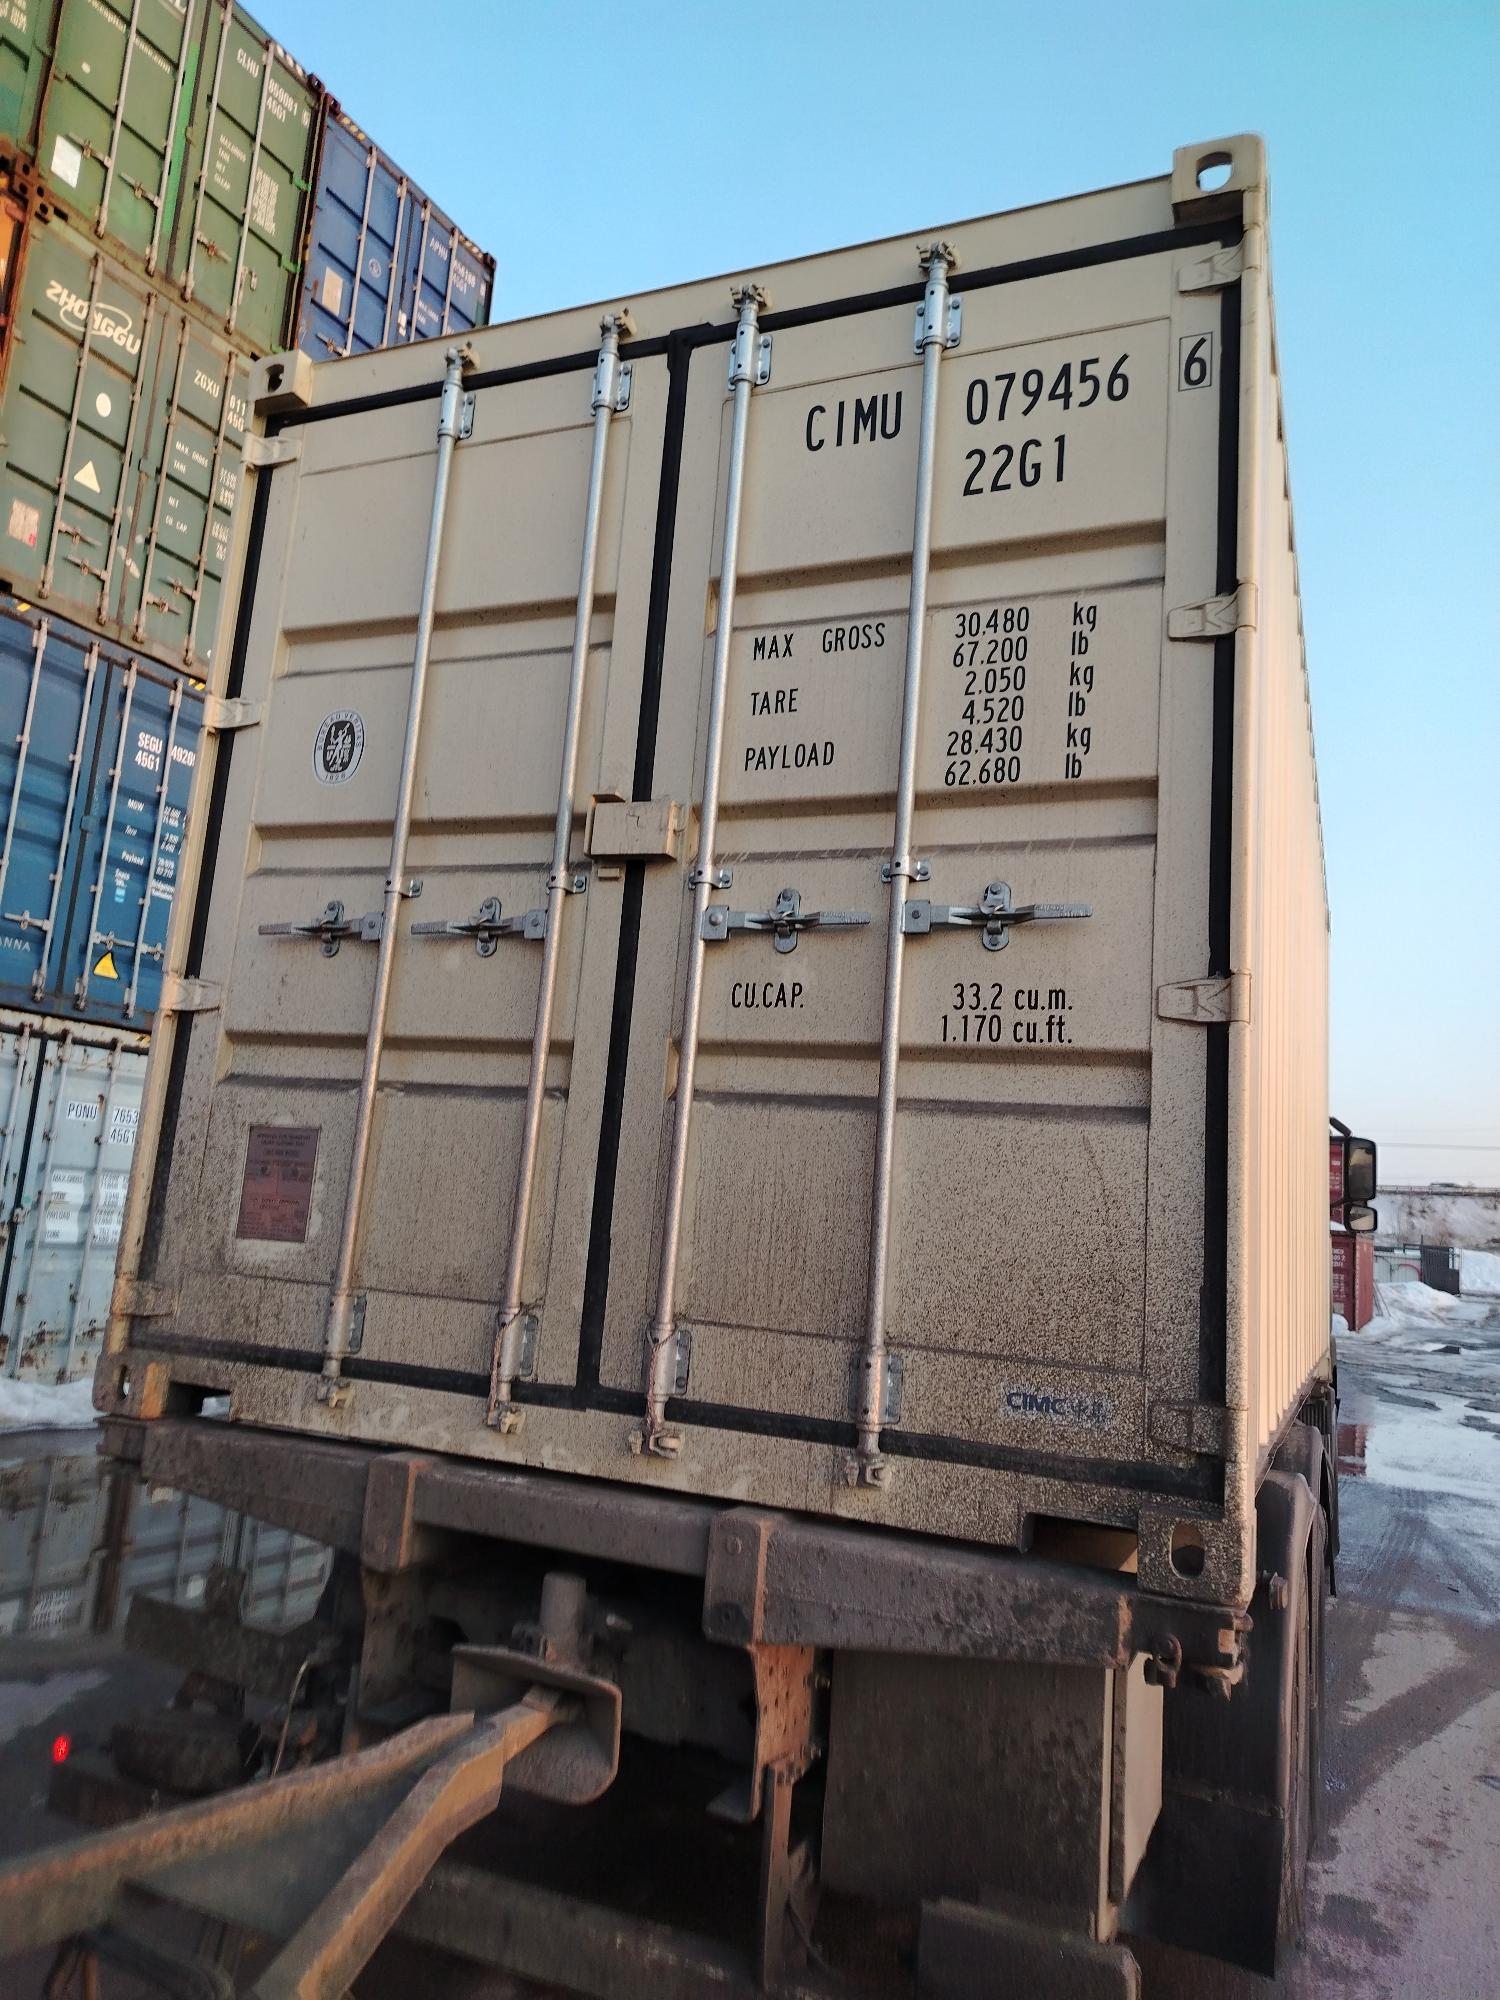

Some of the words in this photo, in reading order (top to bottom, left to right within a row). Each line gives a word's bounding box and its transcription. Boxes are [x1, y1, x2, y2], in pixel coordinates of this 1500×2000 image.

[236, 48, 259, 78] CLHU
[45, 280, 141, 355] ZHONGGU
[194, 370, 220, 398] ZGXU
[806, 391, 903, 452] CIMU
[966, 353, 1130, 425] 079456
[1184, 337, 1207, 386] 6
[962, 434, 1066, 496] 22G1
[753, 633, 794, 661] MAX
[822, 623, 886, 654] GROSS
[1073, 602, 1098, 632] kg
[1071, 631, 1089, 656] lb
[750, 688, 798, 716] TARE
[1069, 662, 1094, 693] kg
[1068, 692, 1086, 717] lb
[137, 732, 163, 754] SEGU
[317, 713, 341, 751] BUREAU
[745, 741, 835, 771] PAYLOAD
[1066, 722, 1092, 754] kg
[1065, 753, 1082, 779] lb
[0, 936, 31, 952] NNA
[732, 982, 805, 1009] CU.CAP.
[952, 982, 1003, 1011] 33.2
[1014, 988, 1073, 1011] cu.m.
[1013, 1015, 1073, 1043] cu.ft.
[67, 1102, 97, 1121] PONU
[110, 1128, 135, 1144] 45G1
[1007, 1392, 1066, 1415] CIMC
